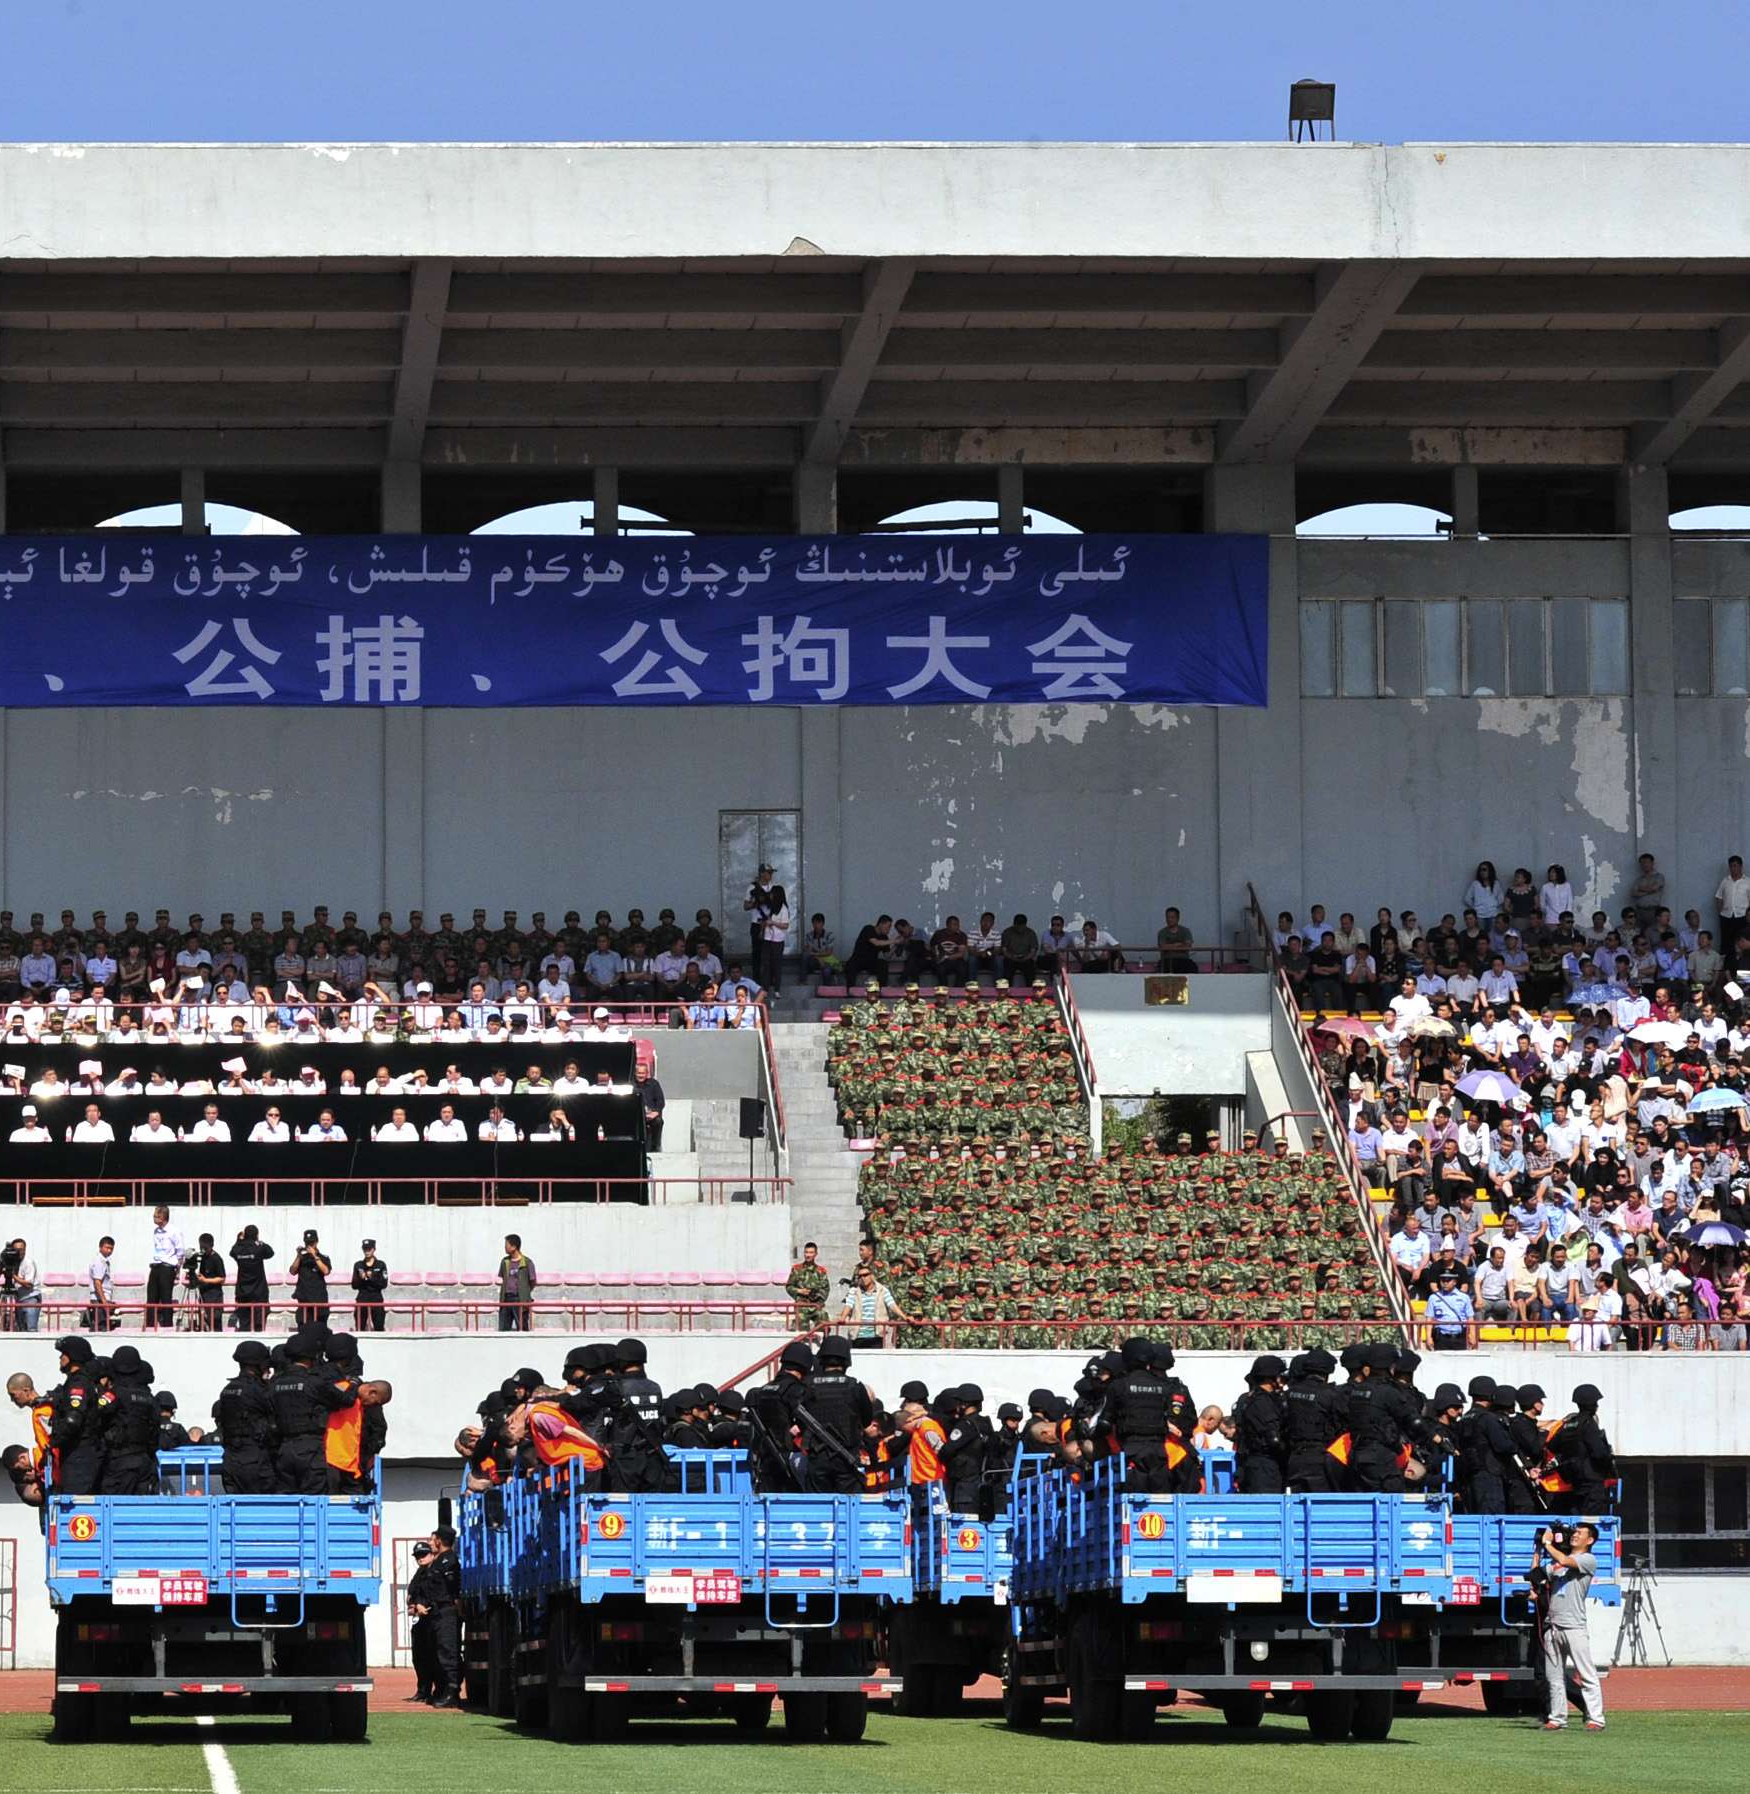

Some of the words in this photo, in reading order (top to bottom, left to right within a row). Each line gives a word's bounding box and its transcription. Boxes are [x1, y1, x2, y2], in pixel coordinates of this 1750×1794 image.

[75, 1516, 90, 1538] 8
[604, 1515, 619, 1537] 9
[1144, 1513, 1161, 1536] 10
[963, 1531, 975, 1548] 3
